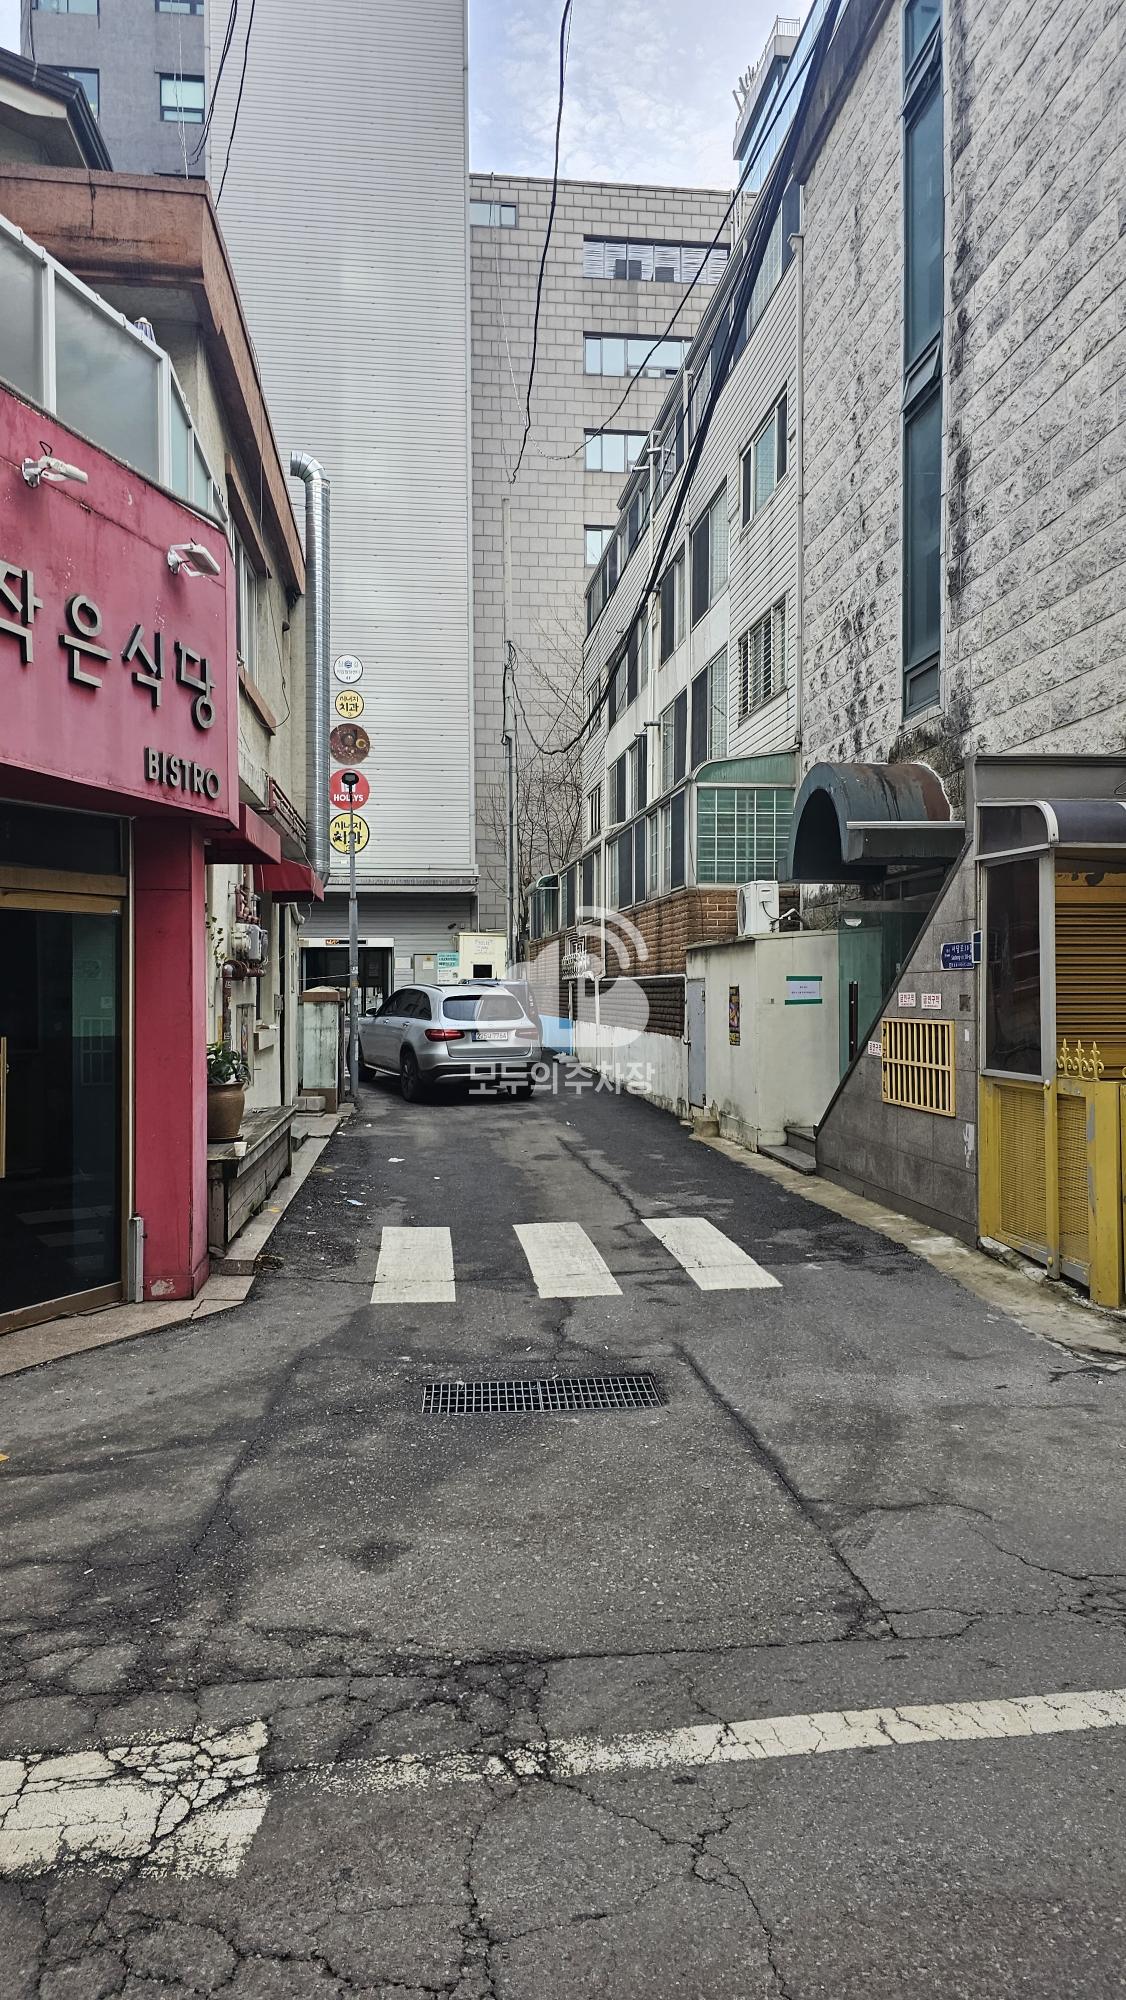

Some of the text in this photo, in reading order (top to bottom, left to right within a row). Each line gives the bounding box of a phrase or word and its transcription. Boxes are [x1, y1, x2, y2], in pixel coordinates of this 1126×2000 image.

[0, 559, 216, 729] 작은식당
[339, 702, 359, 712] 치과
[145, 747, 221, 799] BISTRO
[333, 794, 364, 802] HOLYS
